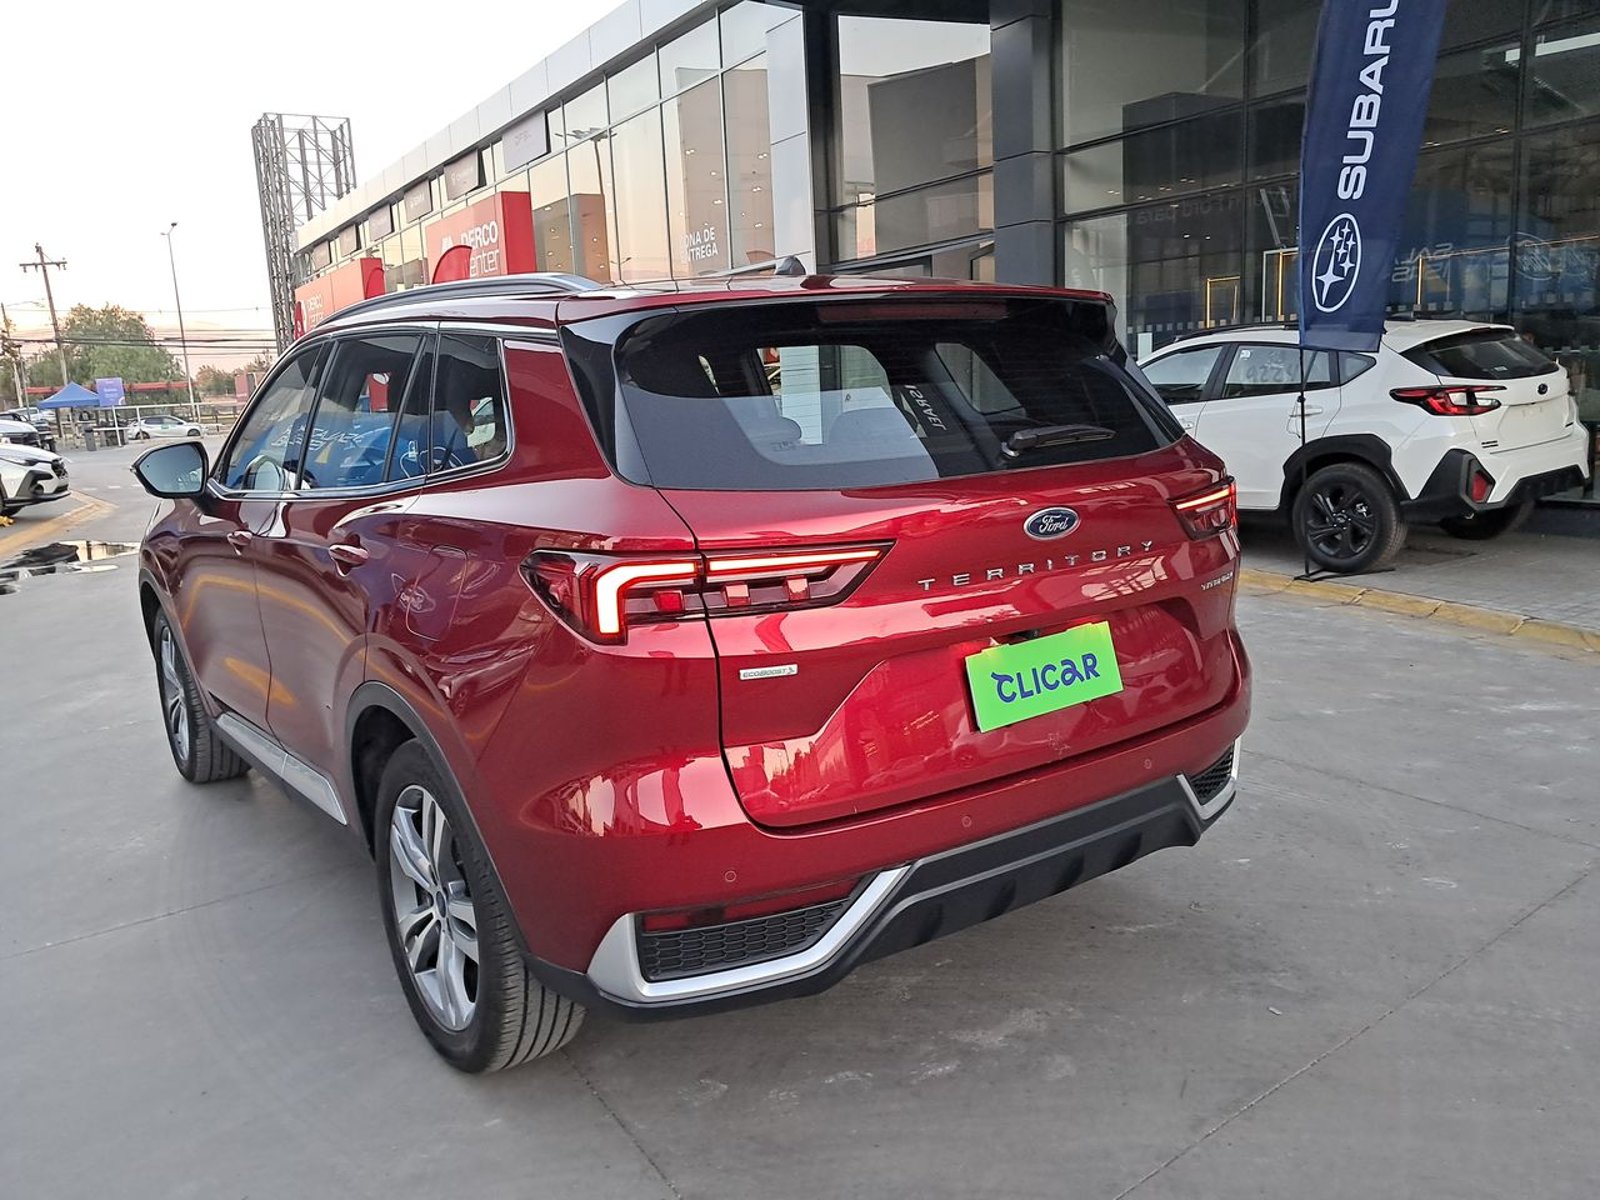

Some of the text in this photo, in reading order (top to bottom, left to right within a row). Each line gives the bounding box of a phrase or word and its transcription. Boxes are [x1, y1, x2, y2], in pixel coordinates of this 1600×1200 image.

[703, 226, 716, 242] DE
[1039, 514, 1069, 533] Ford
[917, 540, 1152, 591] TERRITORY
